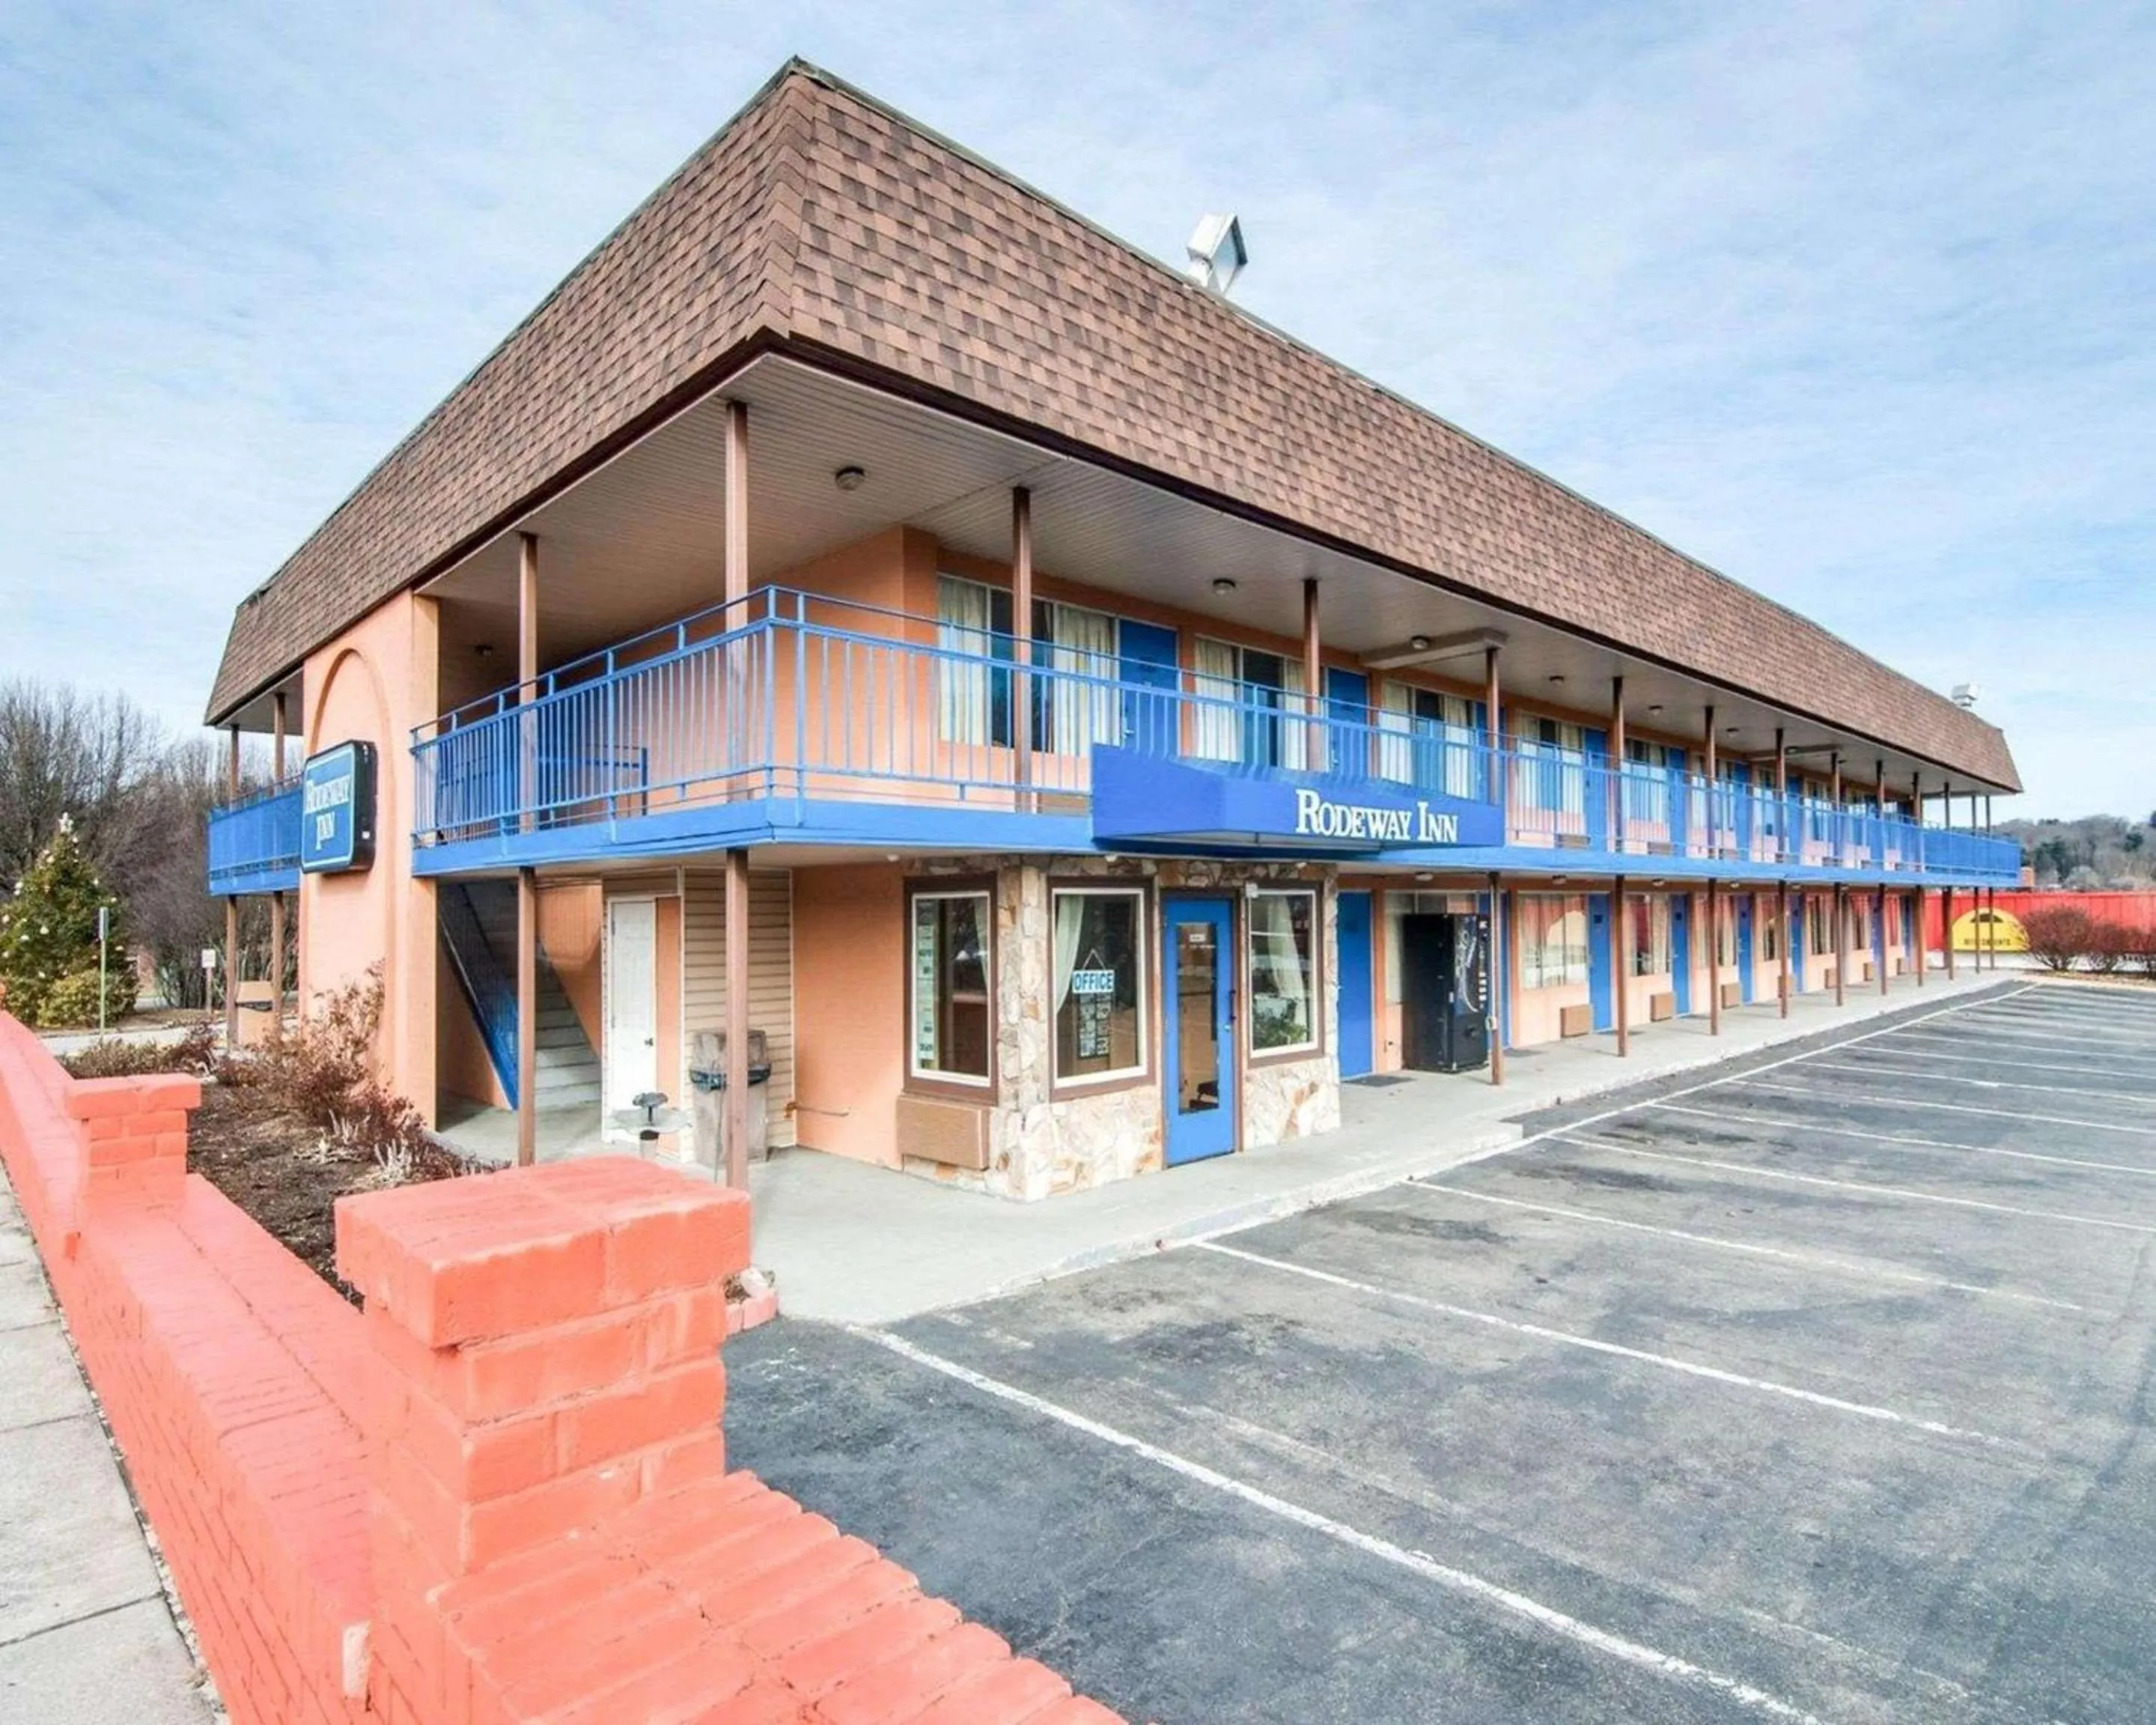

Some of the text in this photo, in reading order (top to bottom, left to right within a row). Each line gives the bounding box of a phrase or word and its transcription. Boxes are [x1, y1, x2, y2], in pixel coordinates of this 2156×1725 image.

[1295, 788, 1458, 843] RODEWAY INN
[1074, 973, 1113, 991] OFFICE
